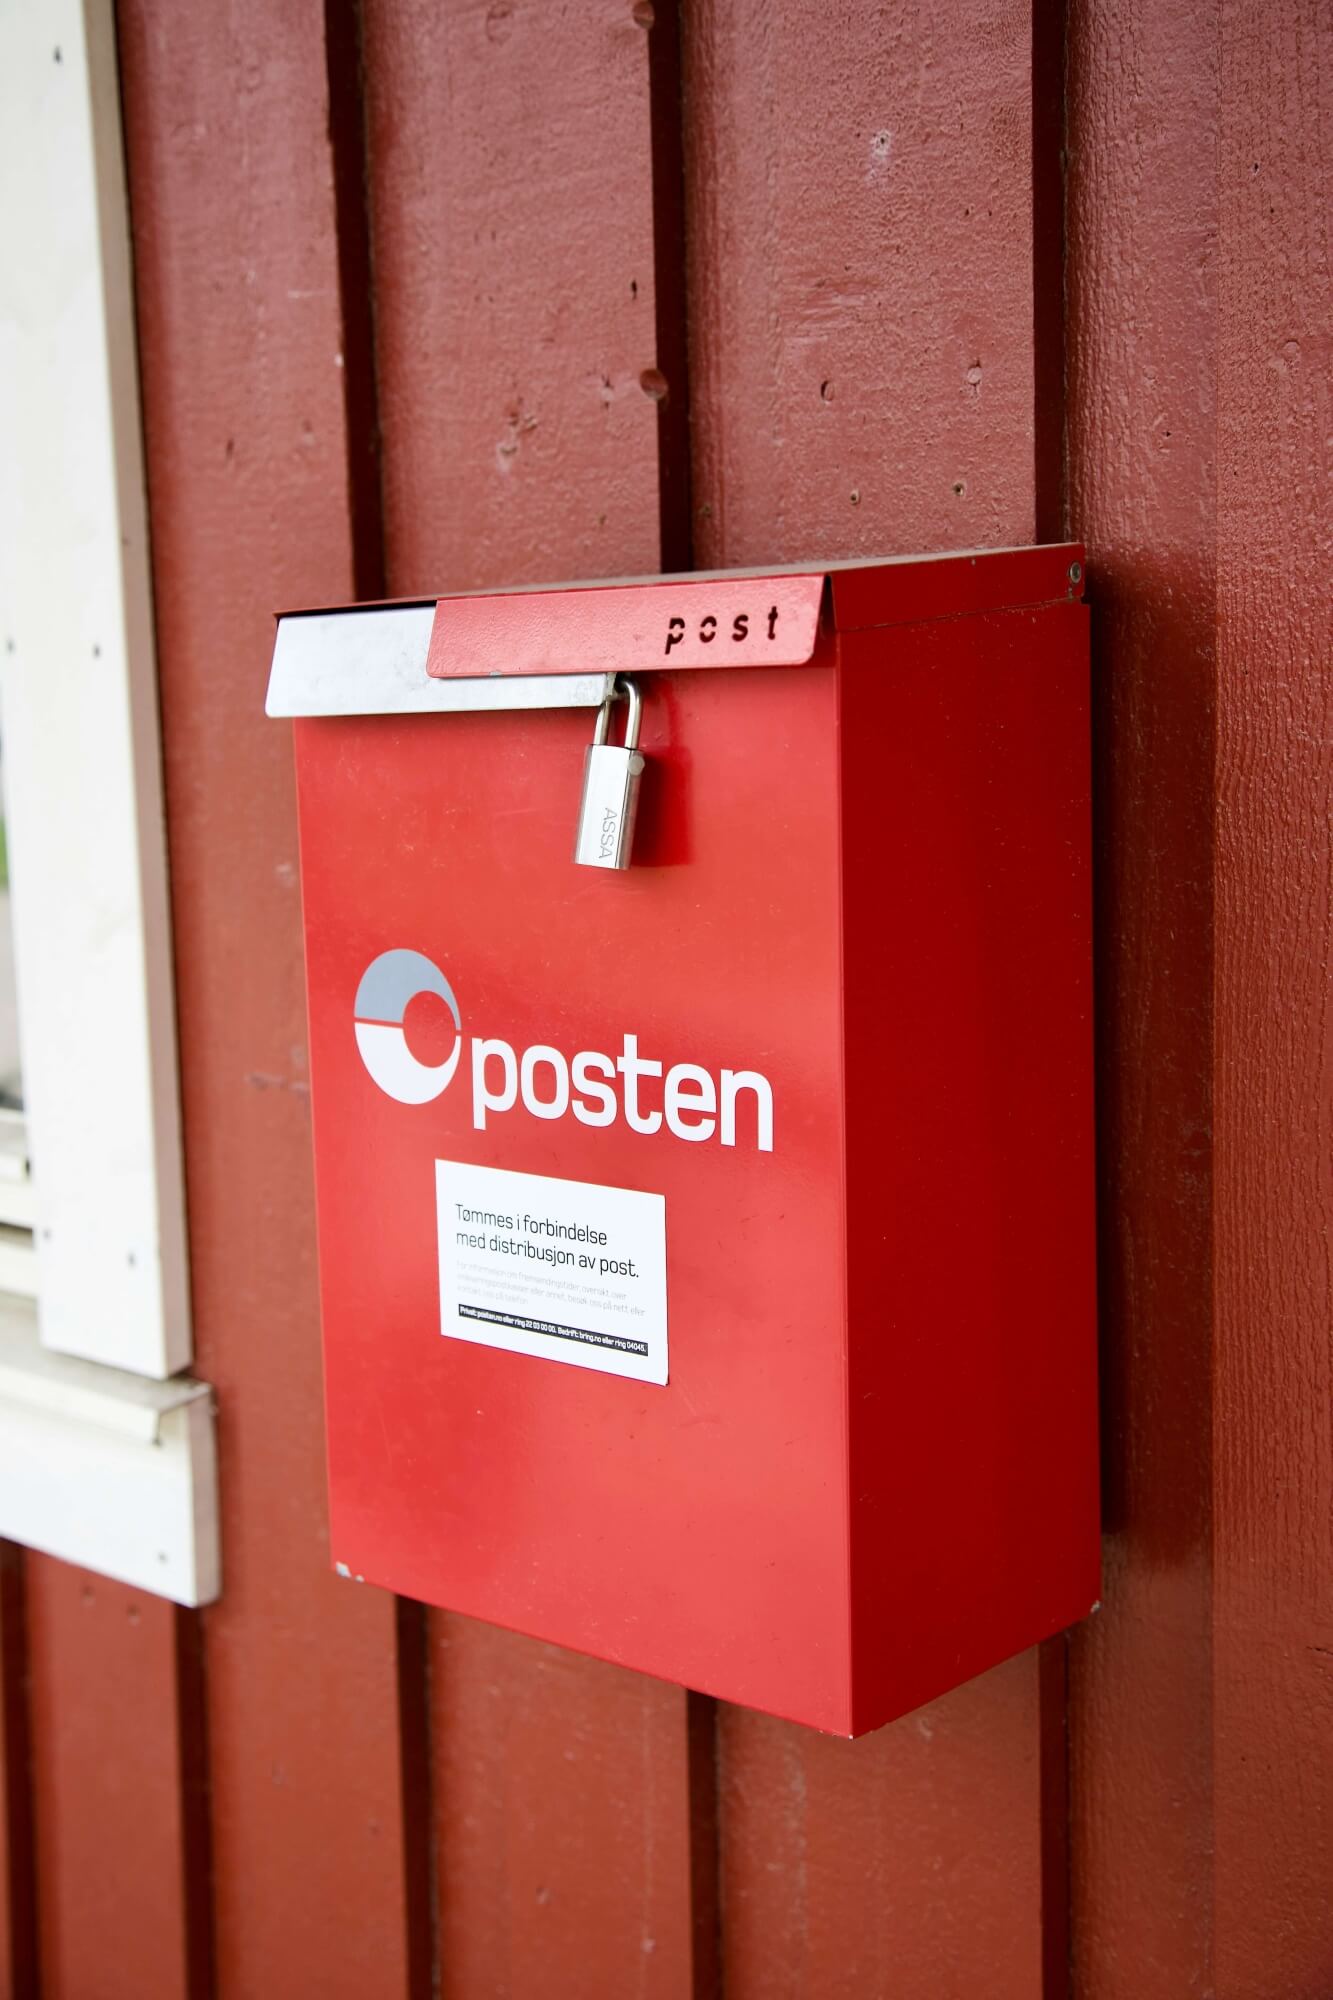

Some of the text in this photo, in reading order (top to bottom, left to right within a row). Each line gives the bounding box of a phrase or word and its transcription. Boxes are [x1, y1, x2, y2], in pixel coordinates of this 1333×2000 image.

[665, 607, 778, 654] post
[599, 807, 617, 859] ASSA
[472, 1034, 773, 1151] posten
[456, 1204, 607, 1245] Tømmes i forbindelse
[457, 1232, 639, 1278] med distribusjon av post.
[515, 1319, 526, 1327] ring
[526, 1320, 532, 1328] 22
[558, 1327, 579, 1337] Bedrift:
[580, 1332, 601, 1342] bring.no
[615, 1340, 626, 1349] ring
[627, 1341, 646, 1352] 04045.
